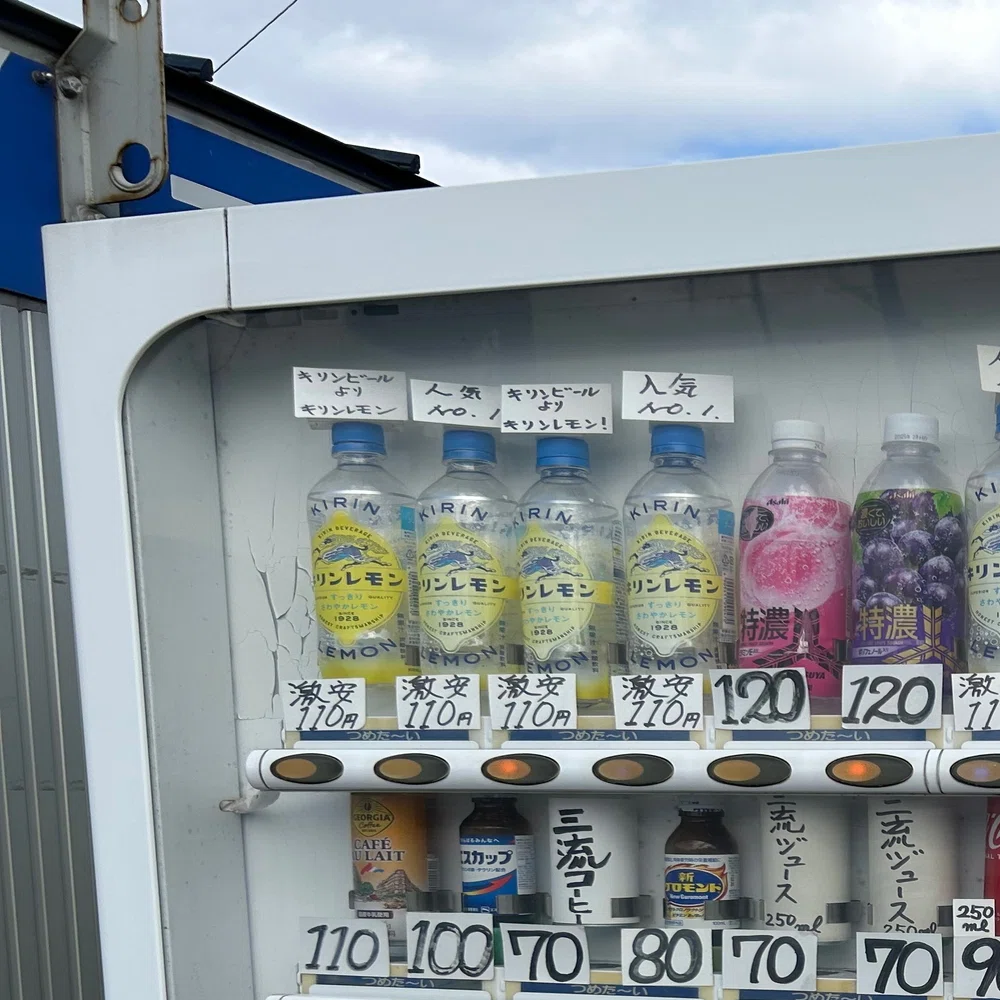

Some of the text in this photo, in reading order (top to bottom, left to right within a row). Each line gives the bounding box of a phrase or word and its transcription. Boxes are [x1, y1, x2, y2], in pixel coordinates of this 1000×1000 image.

[296, 370, 395, 385] キリンビール
[333, 384, 364, 398] より
[423, 384, 484, 402] 人気
[506, 386, 601, 402] キリンビール
[537, 398, 564, 413] より
[299, 402, 399, 417] キリンレモン
[310, 496, 381, 517] KIRIN
[418, 502, 489, 523] KIRIN
[630, 500, 700, 521] KIRIN
[856, 604, 919, 641] 特濃
[288, 680, 358, 707] 激安
[402, 675, 471, 702] 激安
[498, 674, 566, 700] 激安
[621, 674, 695, 701] 激安
[714, 669, 807, 726] 120
[841, 675, 937, 726] 120
[295, 704, 359, 731] 110円
[404, 700, 474, 730] 110円
[500, 700, 571, 730] 110円
[624, 699, 701, 728] 110円
[365, 850, 406, 862] LAIT
[553, 808, 612, 926] 三流コーヒー
[765, 912, 823, 934] 250ml
[956, 904, 994, 920] 250
[305, 923, 381, 972] 110
[407, 919, 495, 978] 100
[507, 929, 584, 982] 70
[628, 928, 703, 984] 80
[731, 934, 806, 985] 70
[864, 938, 941, 995] 70
